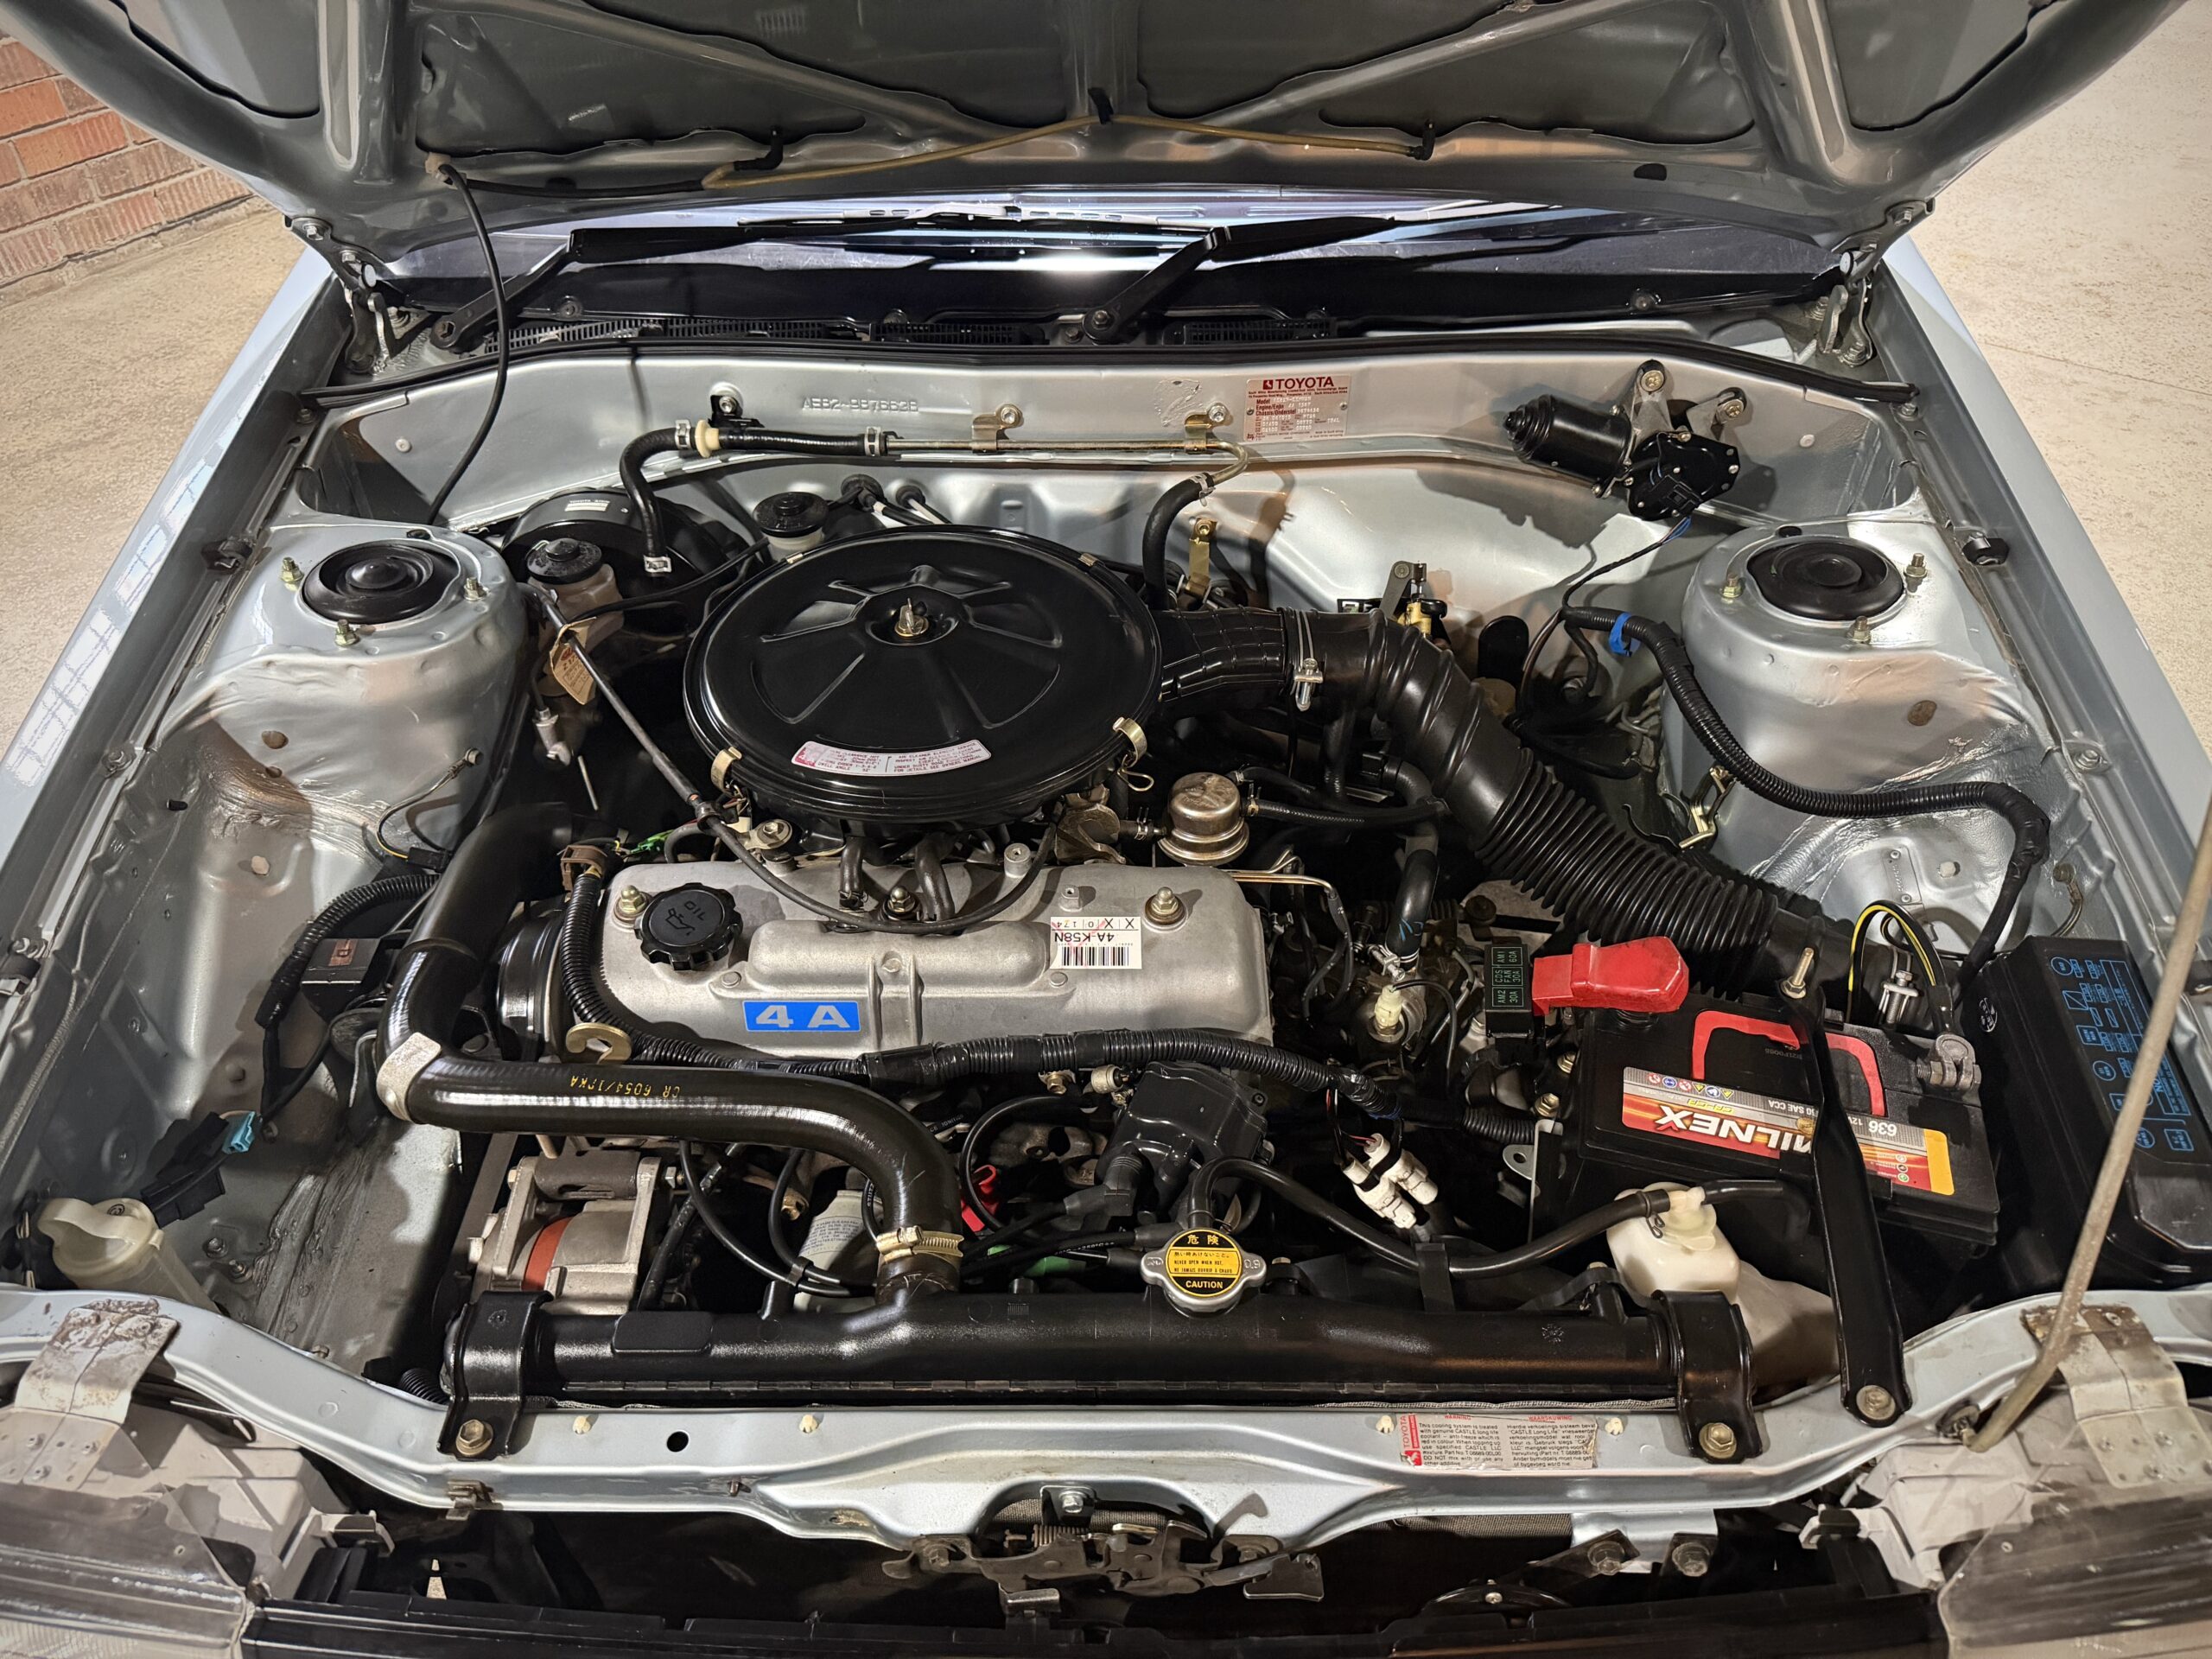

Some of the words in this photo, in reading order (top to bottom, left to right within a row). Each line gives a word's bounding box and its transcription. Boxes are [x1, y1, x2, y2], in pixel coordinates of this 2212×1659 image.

[1275, 376, 1334, 390] TOYOTA
[683, 899, 707, 922] OIL
[1104, 918, 1114, 929] X
[1125, 918, 1135, 929] X
[1054, 931, 1115, 942] 4A-K58N
[1497, 989, 1506, 1003] AM2
[1510, 990, 1518, 1003] 30A
[1768, 1099, 1786, 1109] CCA
[1787, 1103, 1804, 1114] SAE
[1868, 1120, 1897, 1137] 636
[1187, 1234, 1219, 1245] 危険
[1244, 1259, 1262, 1269] 0.9
[1185, 1280, 1224, 1289] CAUTION
[1400, 1415, 1410, 1448] TOYOTA
